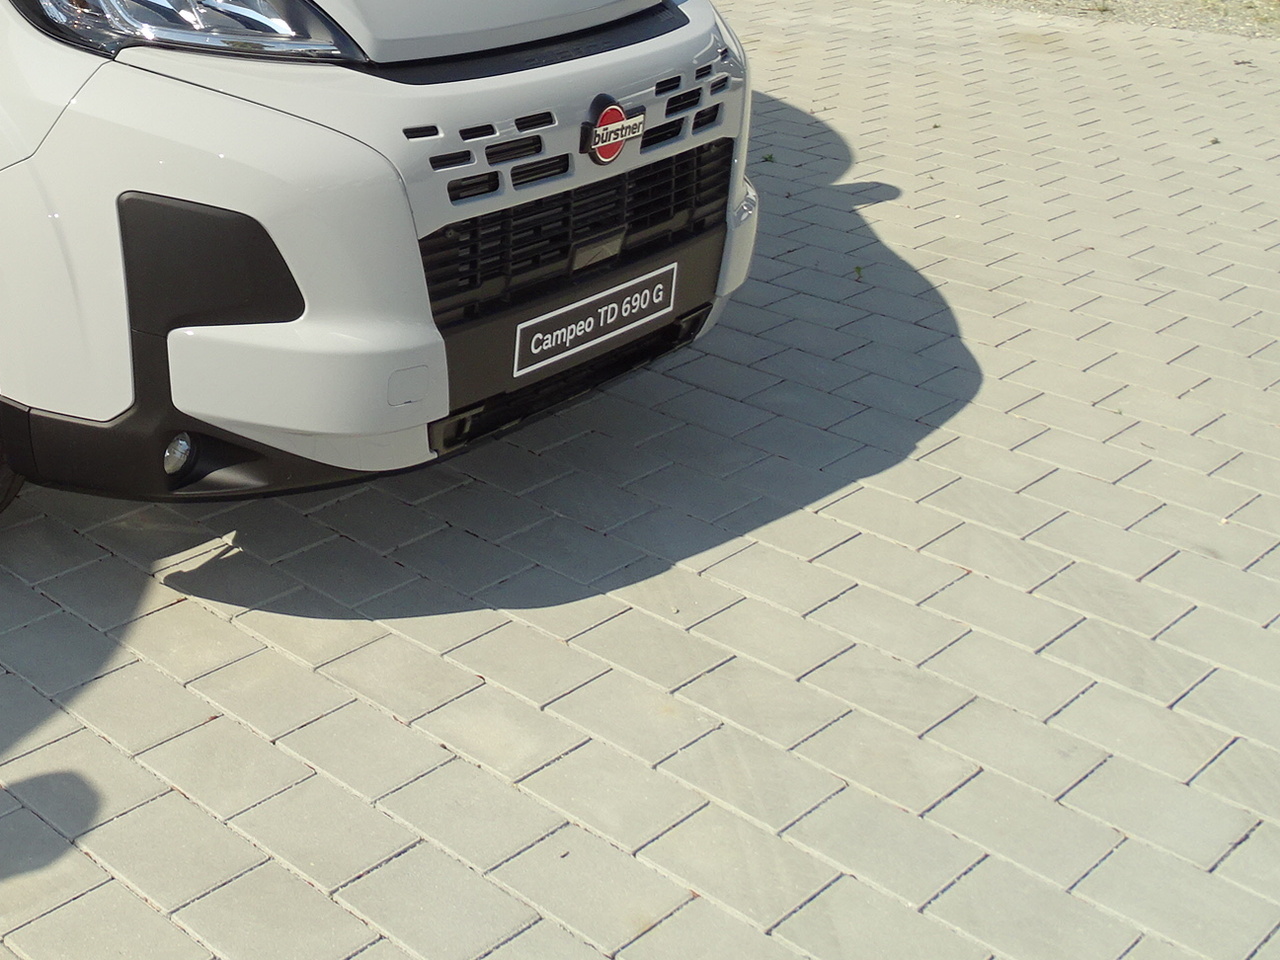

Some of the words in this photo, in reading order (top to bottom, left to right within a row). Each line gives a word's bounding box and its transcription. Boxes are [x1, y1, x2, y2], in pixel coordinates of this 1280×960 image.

[592, 121, 643, 146] bürstner
[530, 316, 595, 355] Campeo
[597, 303, 619, 327] TD
[621, 288, 650, 317] 690
[652, 282, 664, 304] G
